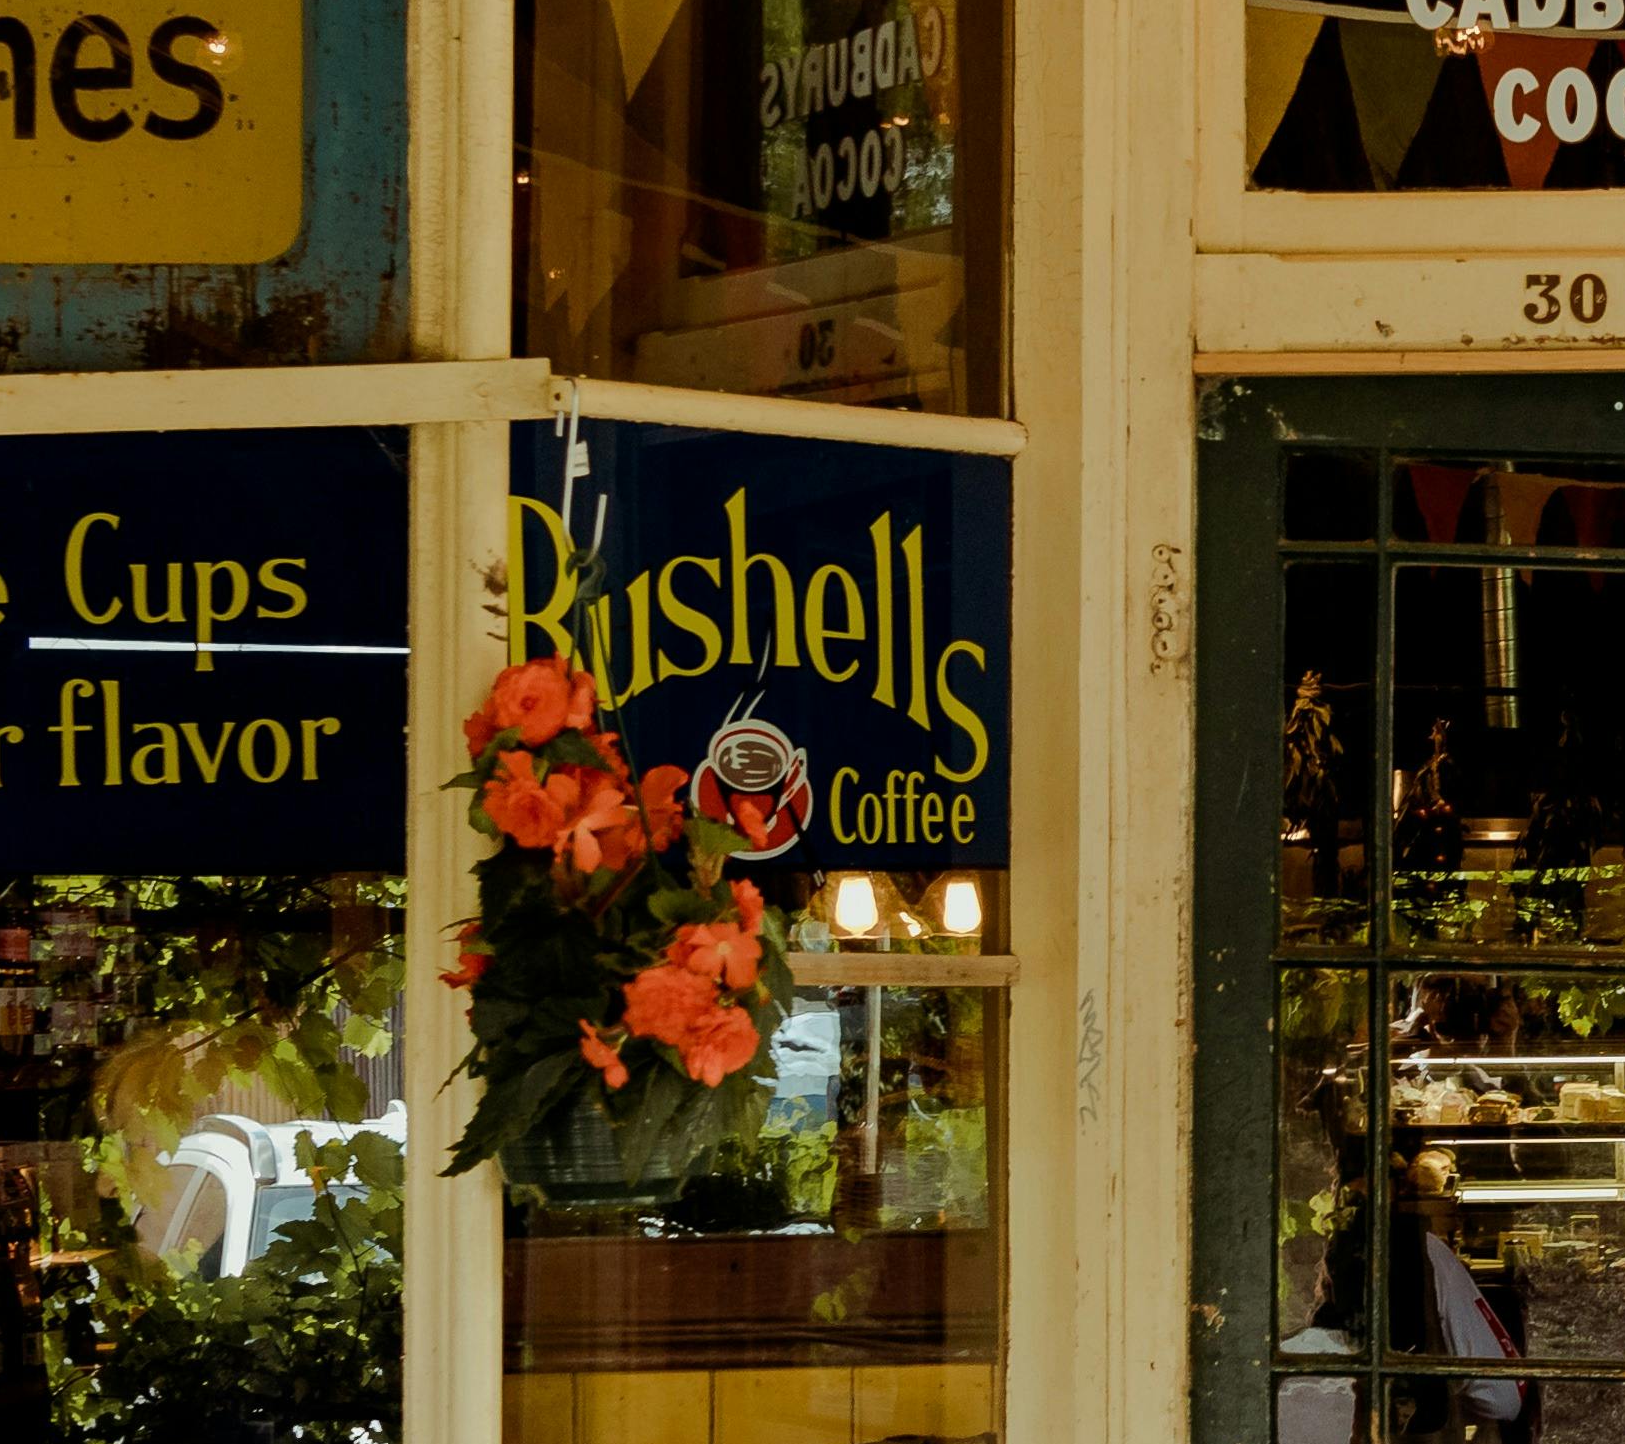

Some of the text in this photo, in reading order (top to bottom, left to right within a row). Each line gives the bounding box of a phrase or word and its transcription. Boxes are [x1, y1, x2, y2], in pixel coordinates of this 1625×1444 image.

[1524, 272, 1608, 325] 30
[64, 511, 310, 674] Cups
[508, 487, 989, 783] Bushells
[48, 677, 341, 787] flavor
[830, 766, 976, 845] Coffee
